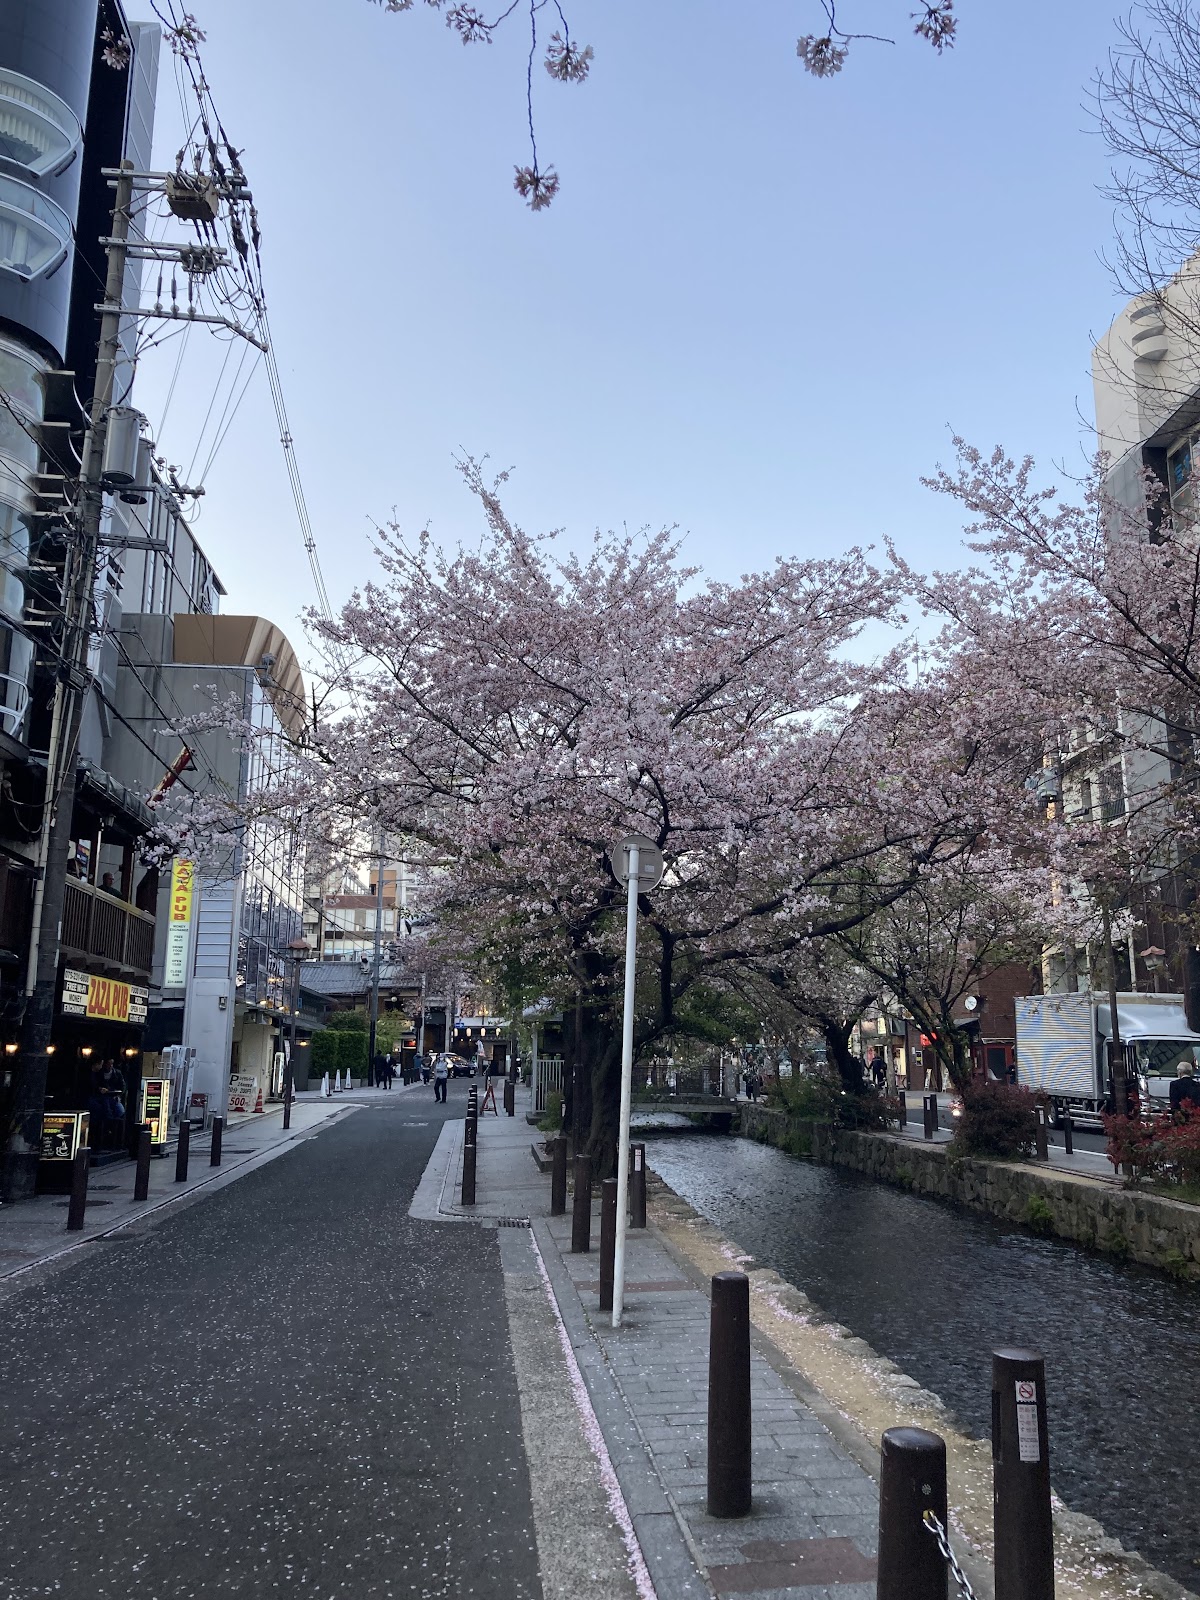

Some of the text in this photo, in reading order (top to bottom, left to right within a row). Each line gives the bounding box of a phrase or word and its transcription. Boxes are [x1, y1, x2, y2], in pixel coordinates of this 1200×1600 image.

[174, 897, 187, 920] PUB
[69, 994, 82, 1003] MONEY
[89, 979, 129, 1018] ZAZA PUB
[230, 1075, 239, 1085] P
